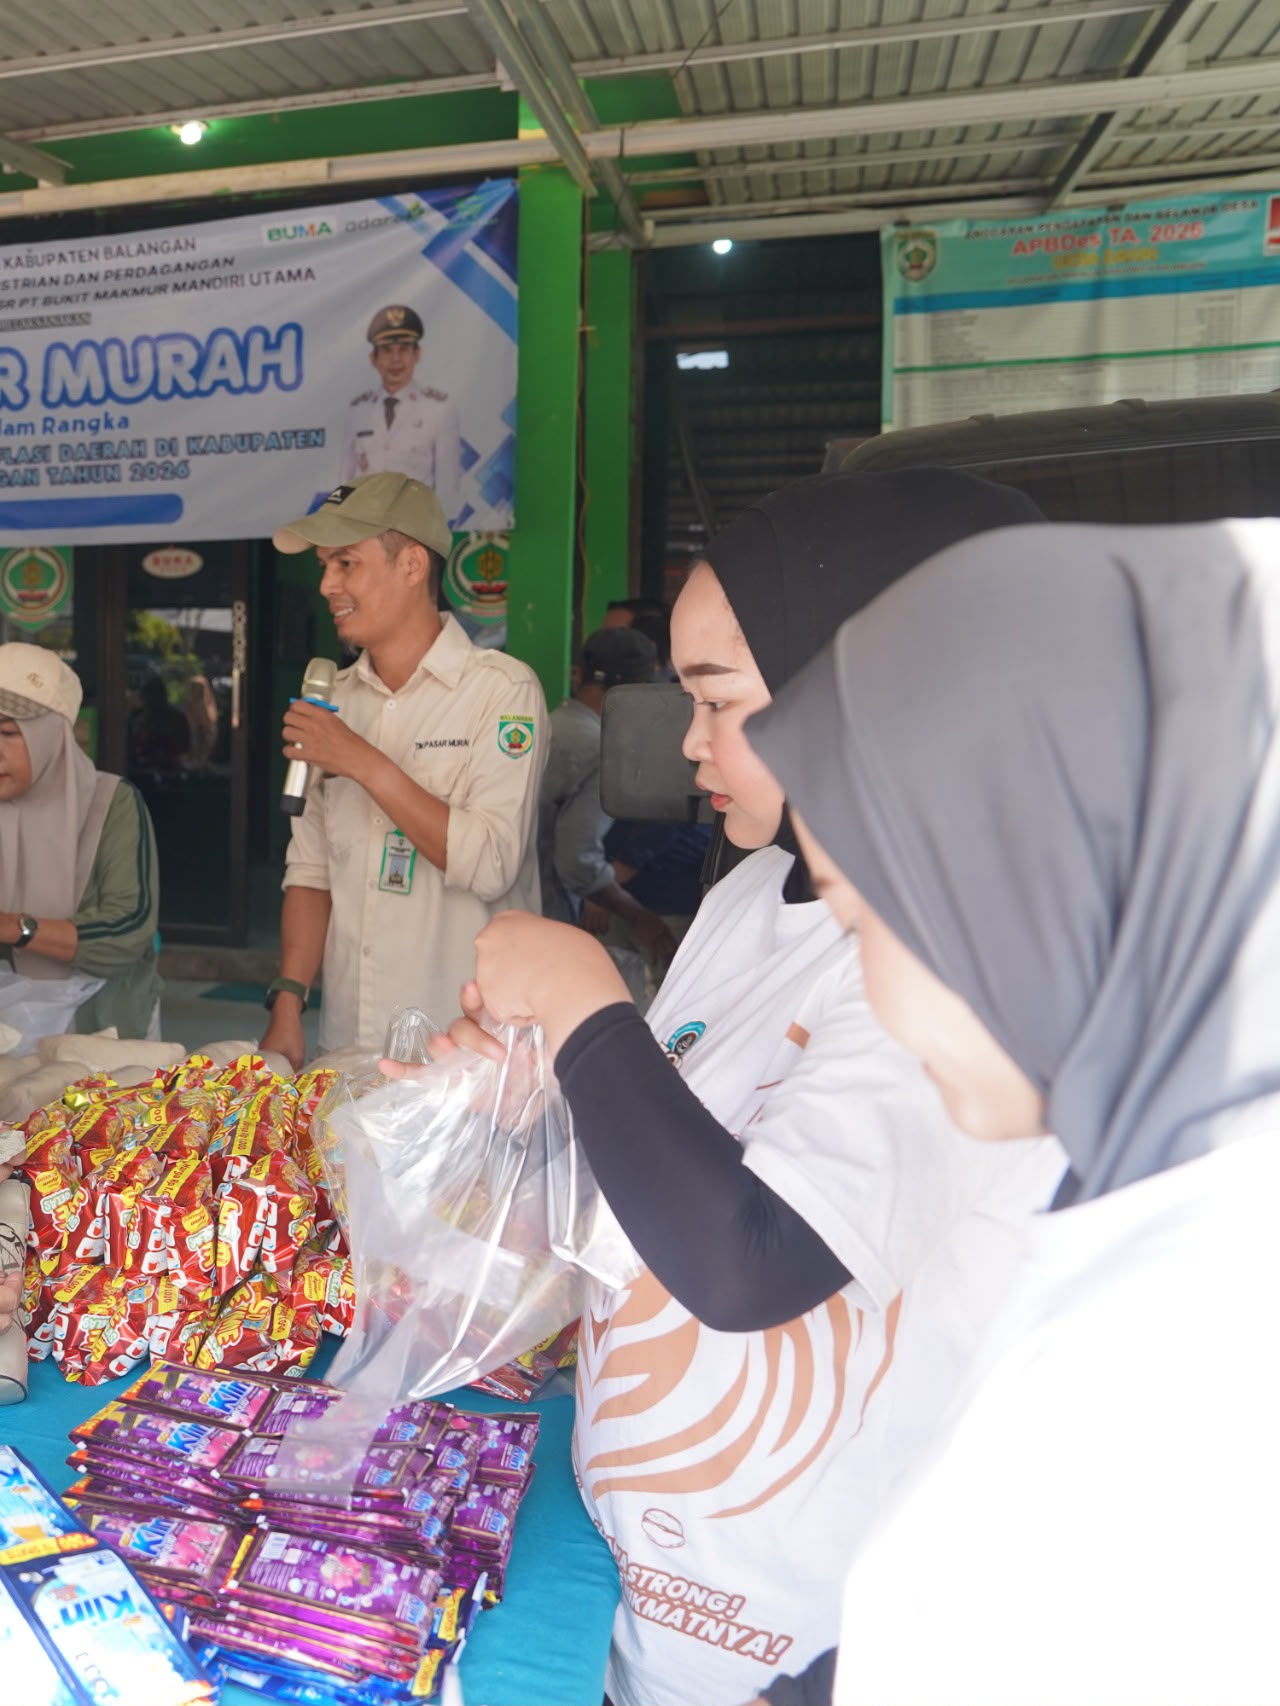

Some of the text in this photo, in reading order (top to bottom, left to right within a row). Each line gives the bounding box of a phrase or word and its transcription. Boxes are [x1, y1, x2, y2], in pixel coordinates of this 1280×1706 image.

[267, 221, 332, 242] BUMA
[1012, 232, 1102, 256] APBDes
[1149, 220, 1205, 243] 2026
[5, 249, 99, 269] KABUPATEN
[104, 238, 197, 261] BALANGAN
[19, 296, 40, 308] PT
[42, 291, 91, 306] BUKIT
[94, 284, 169, 301] MAKMUR
[171, 273, 246, 294] MANDIRI
[249, 267, 316, 287] UTAMA
[64, 271, 99, 286] DAN
[104, 256, 236, 282] PERDAGANGAN
[43, 322, 304, 410] MURAH
[41, 411, 130, 436] Rangka
[58, 439, 147, 462] DAERAH
[154, 437, 180, 457] DI
[186, 428, 327, 456] KABUPATEN
[46, 463, 122, 486] TAHUN
[129, 459, 191, 481] 2026
[424, 739, 448, 749] PASAR
[209, 1380, 250, 1414] Klin
[168, 1420, 210, 1453] Klin
[131, 1517, 174, 1556] Klin
[60, 1589, 136, 1626] Klin
